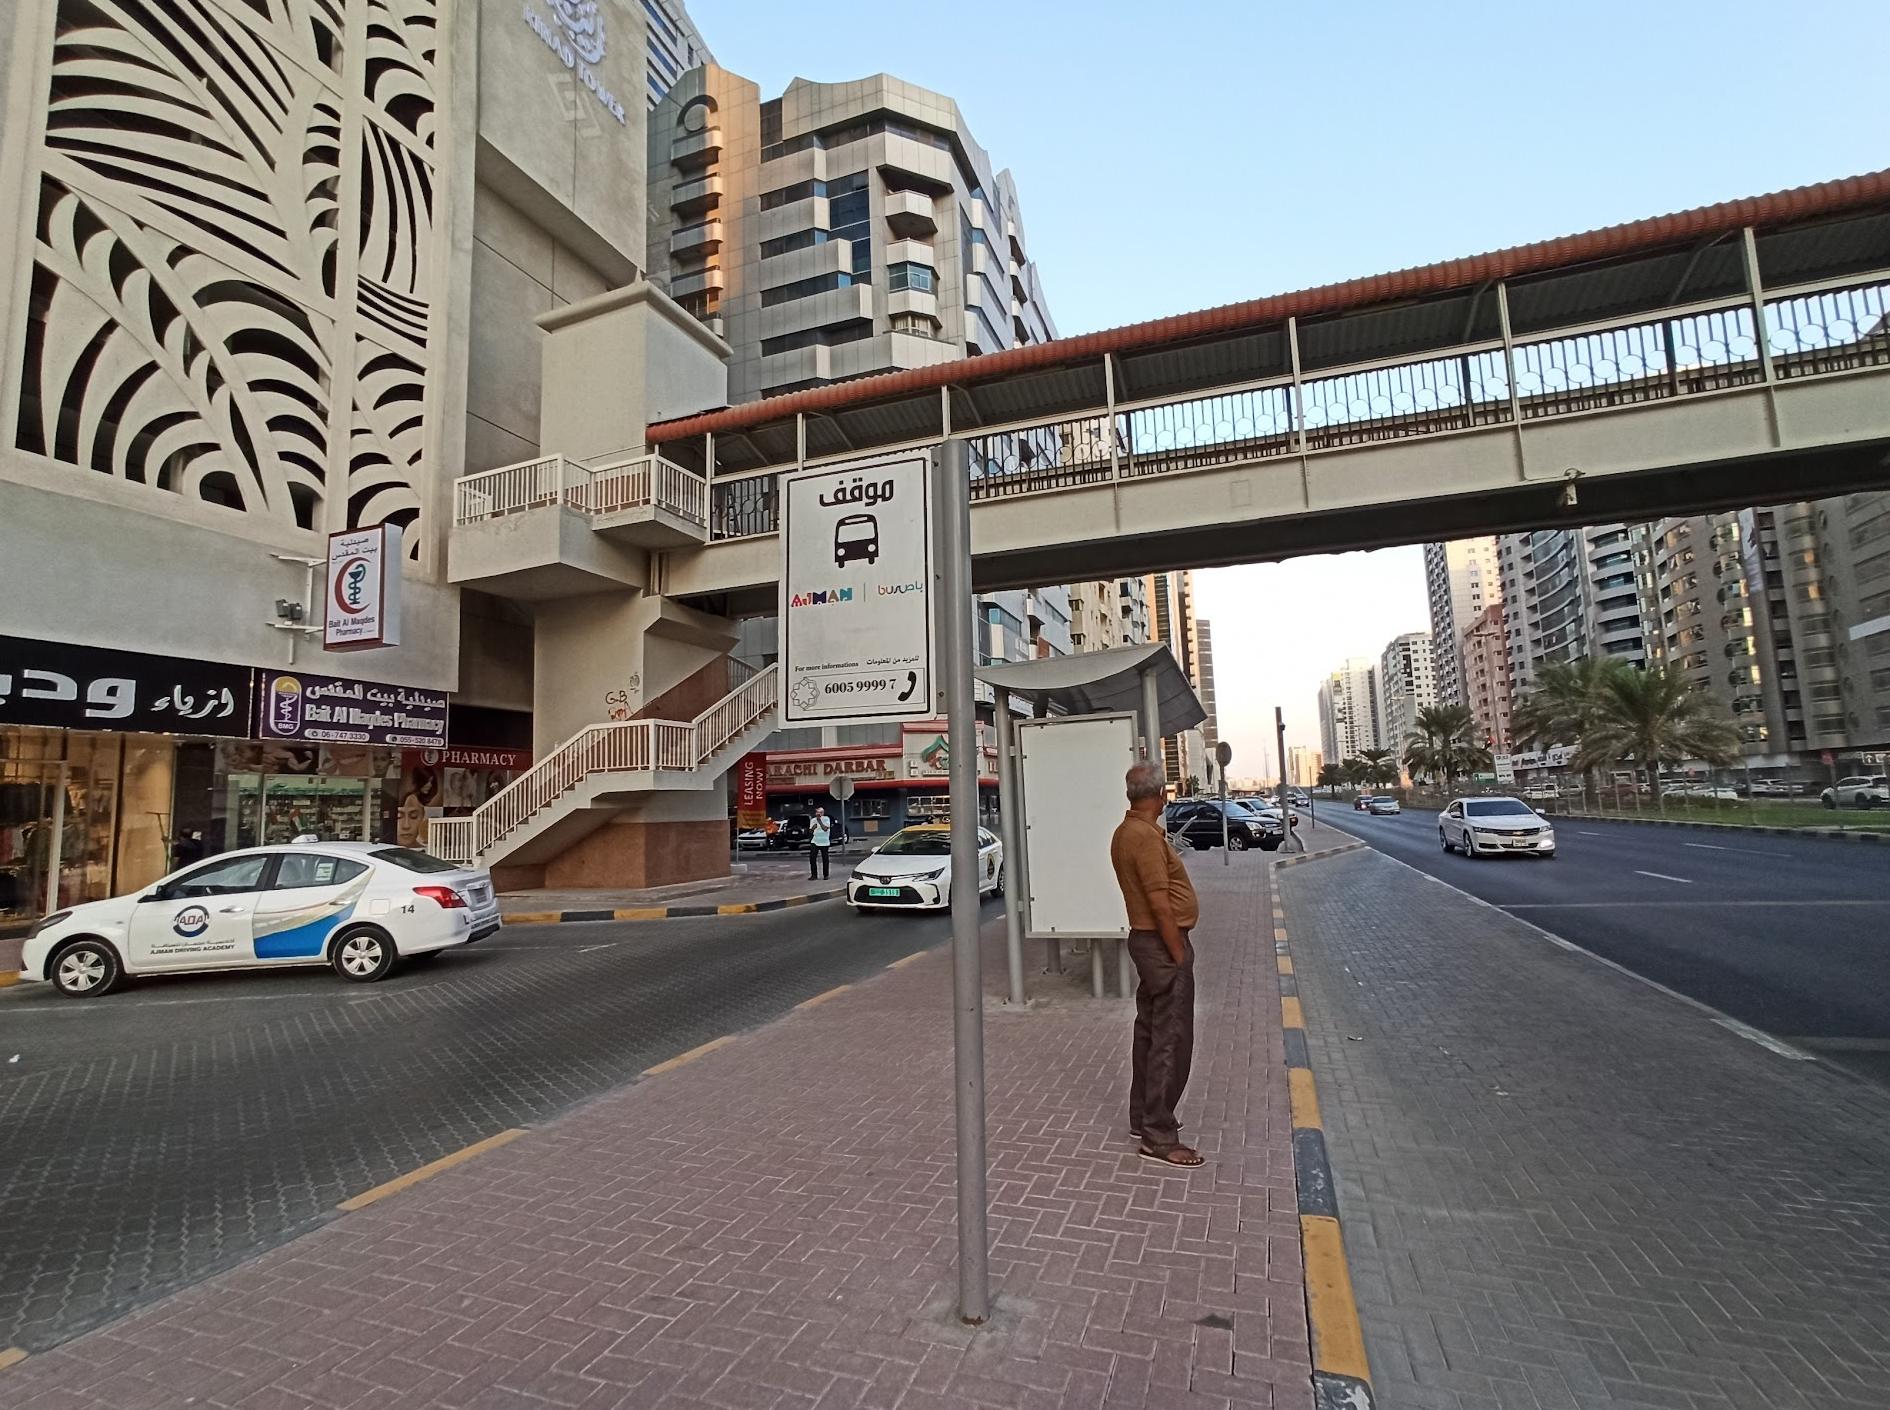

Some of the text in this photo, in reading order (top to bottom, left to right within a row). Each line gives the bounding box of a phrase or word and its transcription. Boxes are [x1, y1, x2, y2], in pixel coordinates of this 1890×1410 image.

[819, 477, 894, 507] موقف
[791, 587, 853, 607] AJMAN
[329, 620, 341, 629] Bait
[351, 616, 375, 626] Maqdes
[336, 628, 363, 636] Pharmacy
[821, 661, 859, 670] informations
[306, 681, 446, 711] صيدلية بيت المقدس
[305, 703, 445, 735] Bait Al Maqdes Pharmacy
[441, 750, 517, 766] PHARMACY
[824, 760, 887, 775] DARBAR
[744, 761, 754, 805] LEASING
[400, 904, 415, 914] 14
[174, 946, 202, 954] DRIVING
